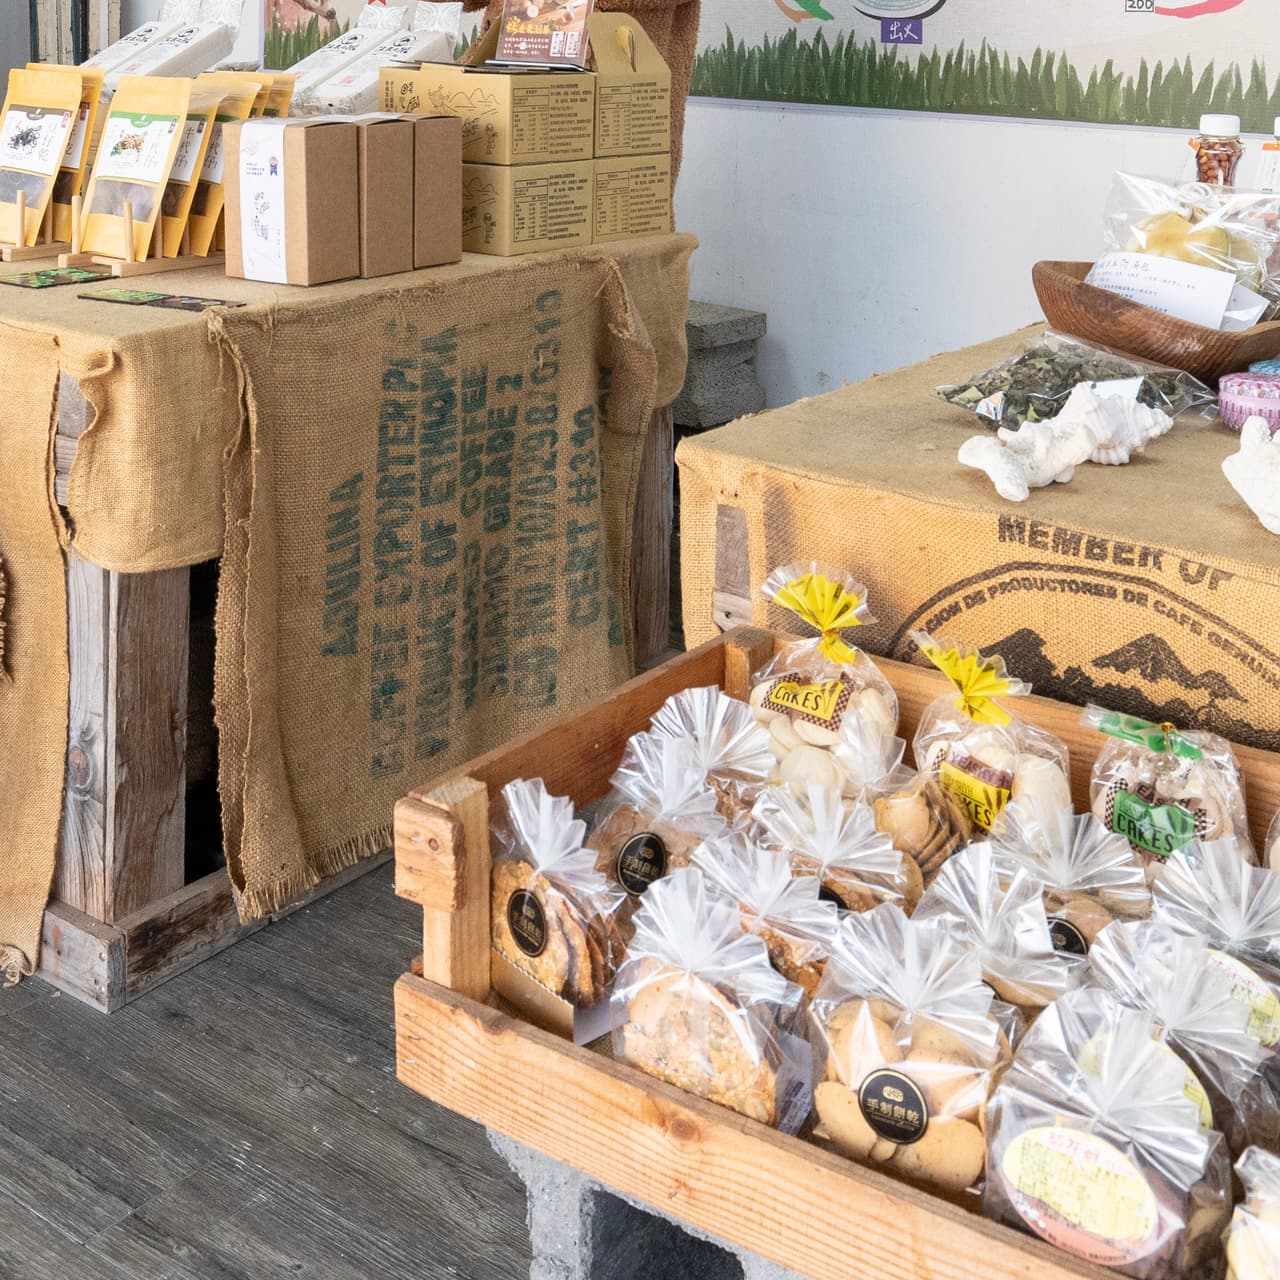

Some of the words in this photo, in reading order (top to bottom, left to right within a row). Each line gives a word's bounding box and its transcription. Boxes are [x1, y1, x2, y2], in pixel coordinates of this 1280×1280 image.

[889, 22, 919, 41] 出火
[419, 324, 458, 508] ETHIOPIA
[496, 373, 524, 394] 2
[459, 361, 490, 518] COFFEE
[483, 405, 517, 533] GRADE
[374, 400, 418, 606] EXPORTER
[420, 517, 458, 567] OF
[564, 518, 601, 629] CERT
[997, 512, 1164, 572] MEMBER
[1179, 556, 1235, 593] OF
[962, 589, 987, 610] DE
[987, 576, 1118, 601] PRODUCTORES
[1122, 587, 1149, 605] DE
[1153, 599, 1205, 636] CAFE
[774, 683, 823, 711] CAKES
[1117, 814, 1174, 853] CAKES
